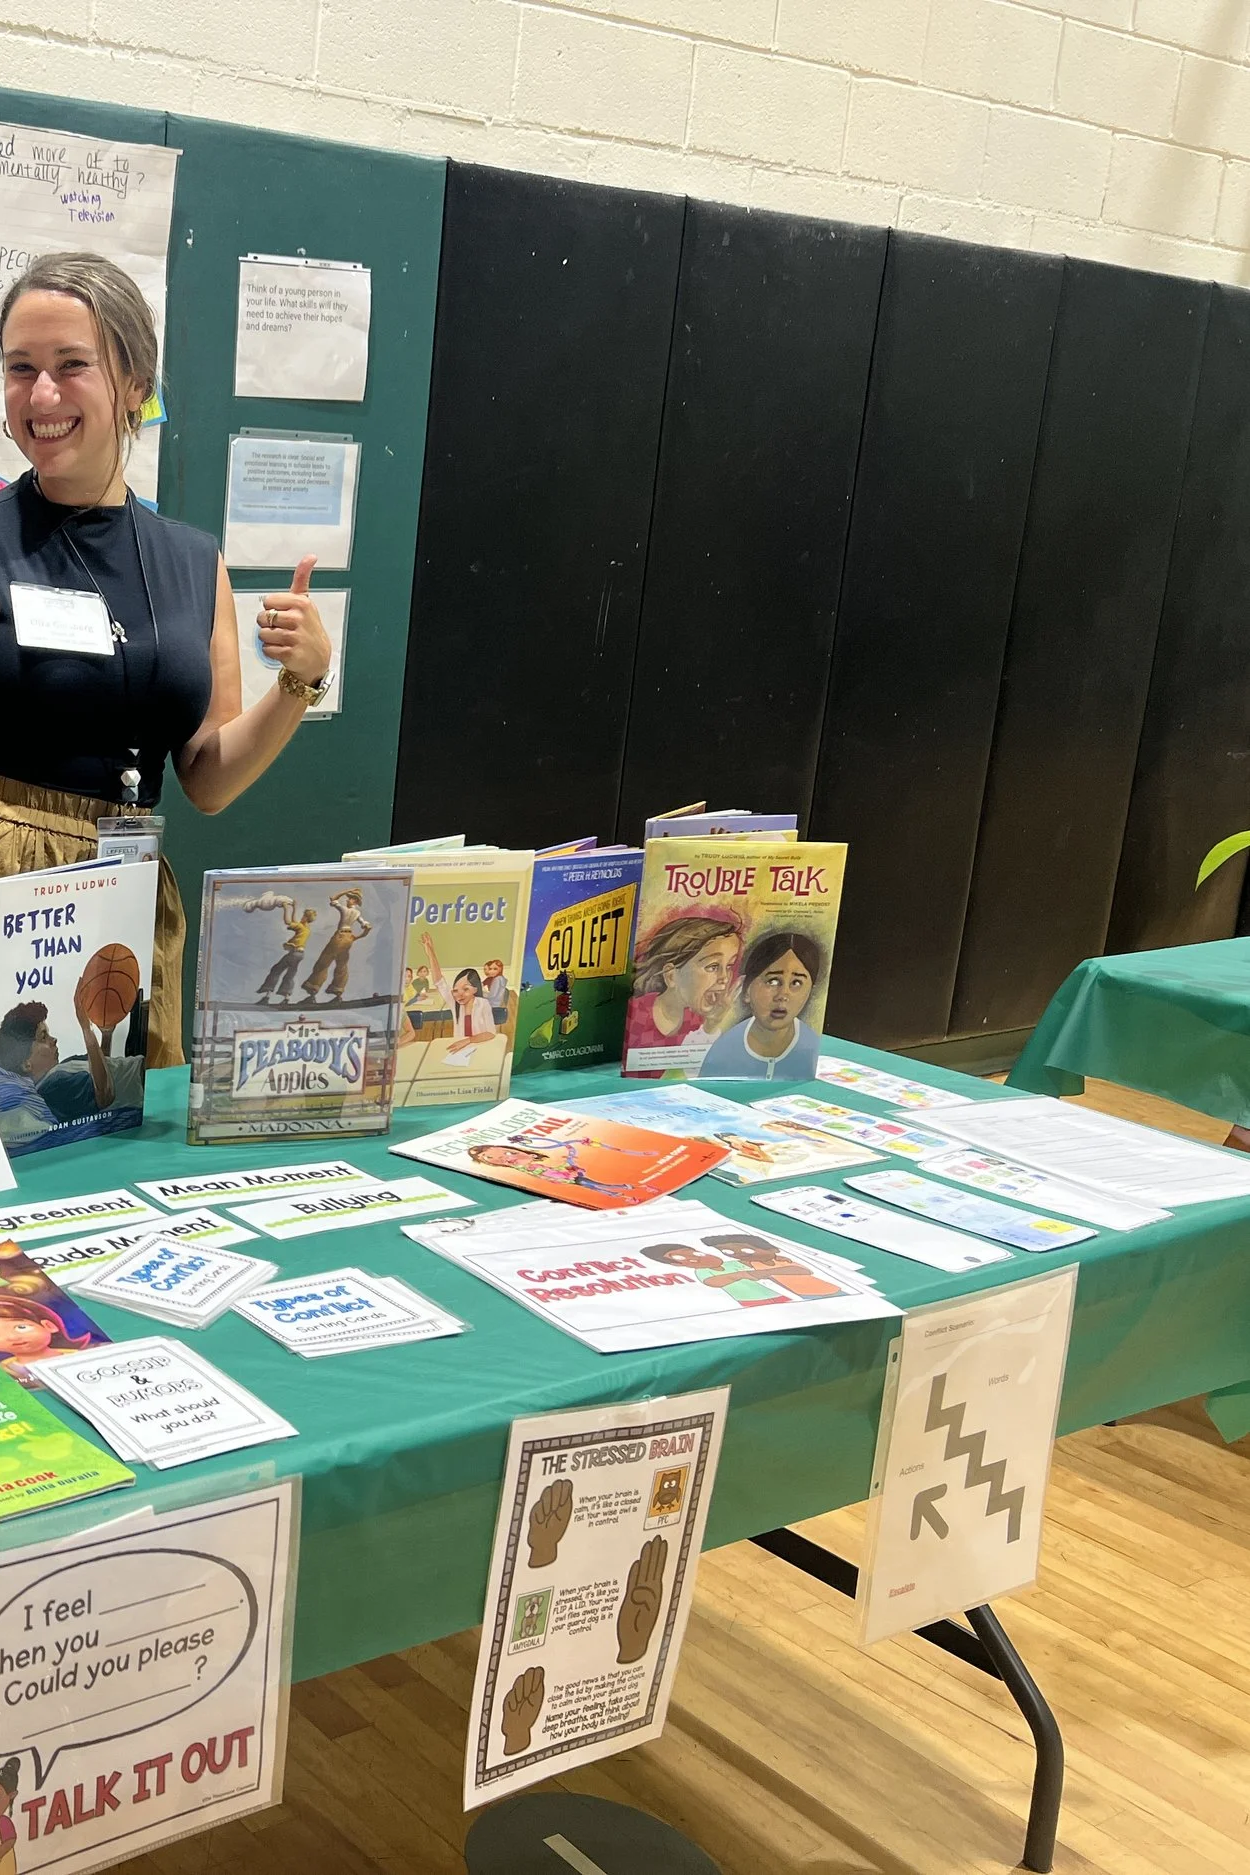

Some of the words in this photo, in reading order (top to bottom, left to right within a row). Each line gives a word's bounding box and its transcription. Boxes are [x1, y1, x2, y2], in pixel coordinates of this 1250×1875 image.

[32, 146, 72, 169] more
[78, 168, 129, 199] healthy
[247, 284, 267, 293] Think
[269, 285, 276, 294] of
[285, 287, 306, 297] young
[308, 288, 332, 298] person
[334, 289, 341, 298] in
[246, 299, 262, 307] your
[280, 298, 298, 308] What
[299, 300, 317, 309] skills
[318, 301, 331, 309] will
[333, 302, 348, 312] they
[246, 310, 264, 319] need
[266, 311, 273, 319] to
[275, 312, 301, 321] achieve
[303, 312, 319, 321] their
[321, 313, 342, 323] hopes
[246, 322, 259, 331] and
[262, 322, 292, 332] dreams?
[34, 884, 70, 896] TRUDY
[76, 877, 117, 891] LUDWIG
[664, 864, 757, 897] TROUBLE
[3, 903, 76, 939] BETTER
[410, 895, 507, 923] Perfect
[31, 935, 82, 959] THAN
[548, 926, 573, 970] GO
[578, 908, 624, 967] LEFT
[16, 966, 53, 994] YOU
[287, 1025, 319, 1038] Mr.
[236, 1031, 362, 1092] PEABODY'S
[261, 1064, 330, 1094] Apples
[48, 1122, 68, 1132] ADAM
[72, 1112, 112, 1126] GUSTAVSON
[248, 1120, 345, 1133] MADONNA
[423, 1108, 545, 1158] TECHNOLOGY
[521, 1115, 574, 1137] TAIL
[157, 1177, 239, 1197] Mean
[246, 1164, 353, 1187] Moment
[292, 1189, 403, 1215] Bullying
[33, 1243, 104, 1270] Rude
[106, 1216, 221, 1250] Moent
[116, 1261, 166, 1285] Types
[158, 1247, 180, 1265] of
[150, 1254, 212, 1292] Conflict
[517, 1257, 647, 1283] Conflict
[249, 1292, 321, 1313] Types
[324, 1285, 352, 1298] of
[524, 1273, 696, 1303] Resolution
[275, 1297, 376, 1323] Conflict
[296, 1318, 346, 1334] Sorting
[348, 1310, 388, 1324] Cards
[924, 1327, 947, 1338] Conflict
[76, 1355, 172, 1384] GOSSIP
[130, 1375, 152, 1385] &
[989, 1374, 1009, 1386] Words
[106, 1378, 203, 1408] RUMORS
[130, 1409, 172, 1424] What
[174, 1397, 220, 1414] should
[160, 1420, 189, 1434] you
[192, 1411, 218, 1424] do?
[542, 1453, 568, 1476] THE
[571, 1441, 646, 1472] STRESSED
[649, 1433, 695, 1460] BRAIN
[899, 1462, 925, 1478] Actions
[657, 1515, 669, 1525] PFC
[24, 1604, 34, 1632] I
[42, 1589, 92, 1626] feel
[52, 1630, 100, 1666] you
[4, 1663, 78, 1706] Could
[84, 1654, 130, 1690] you
[137, 1628, 214, 1672] please
[194, 1655, 208, 1680] ?
[21, 1770, 122, 1841] TALK
[132, 1752, 174, 1804] IT
[180, 1725, 255, 1784] OUT
